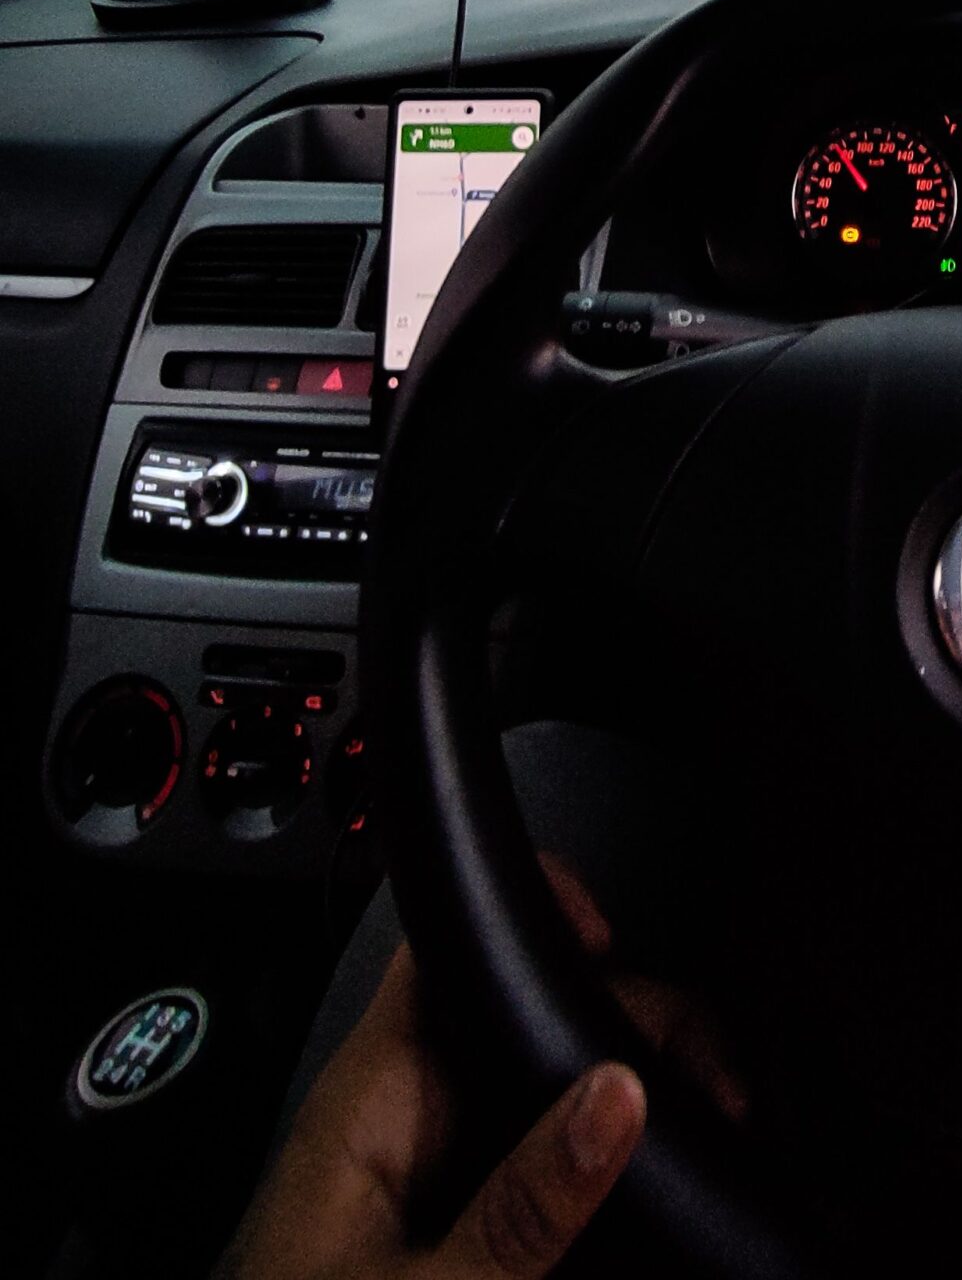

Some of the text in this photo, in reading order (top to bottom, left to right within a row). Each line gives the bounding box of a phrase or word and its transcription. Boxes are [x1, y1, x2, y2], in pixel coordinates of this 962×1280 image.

[857, 141, 874, 153] 100
[879, 141, 896, 153] 120
[897, 150, 914, 162] 140
[828, 161, 841, 174] 60
[907, 163, 924, 175] 160
[819, 177, 832, 189] 40
[916, 179, 933, 191] 180
[815, 197, 829, 209] 20
[914, 199, 935, 211] 200
[820, 215, 828, 227] 0
[911, 215, 931, 228] 220
